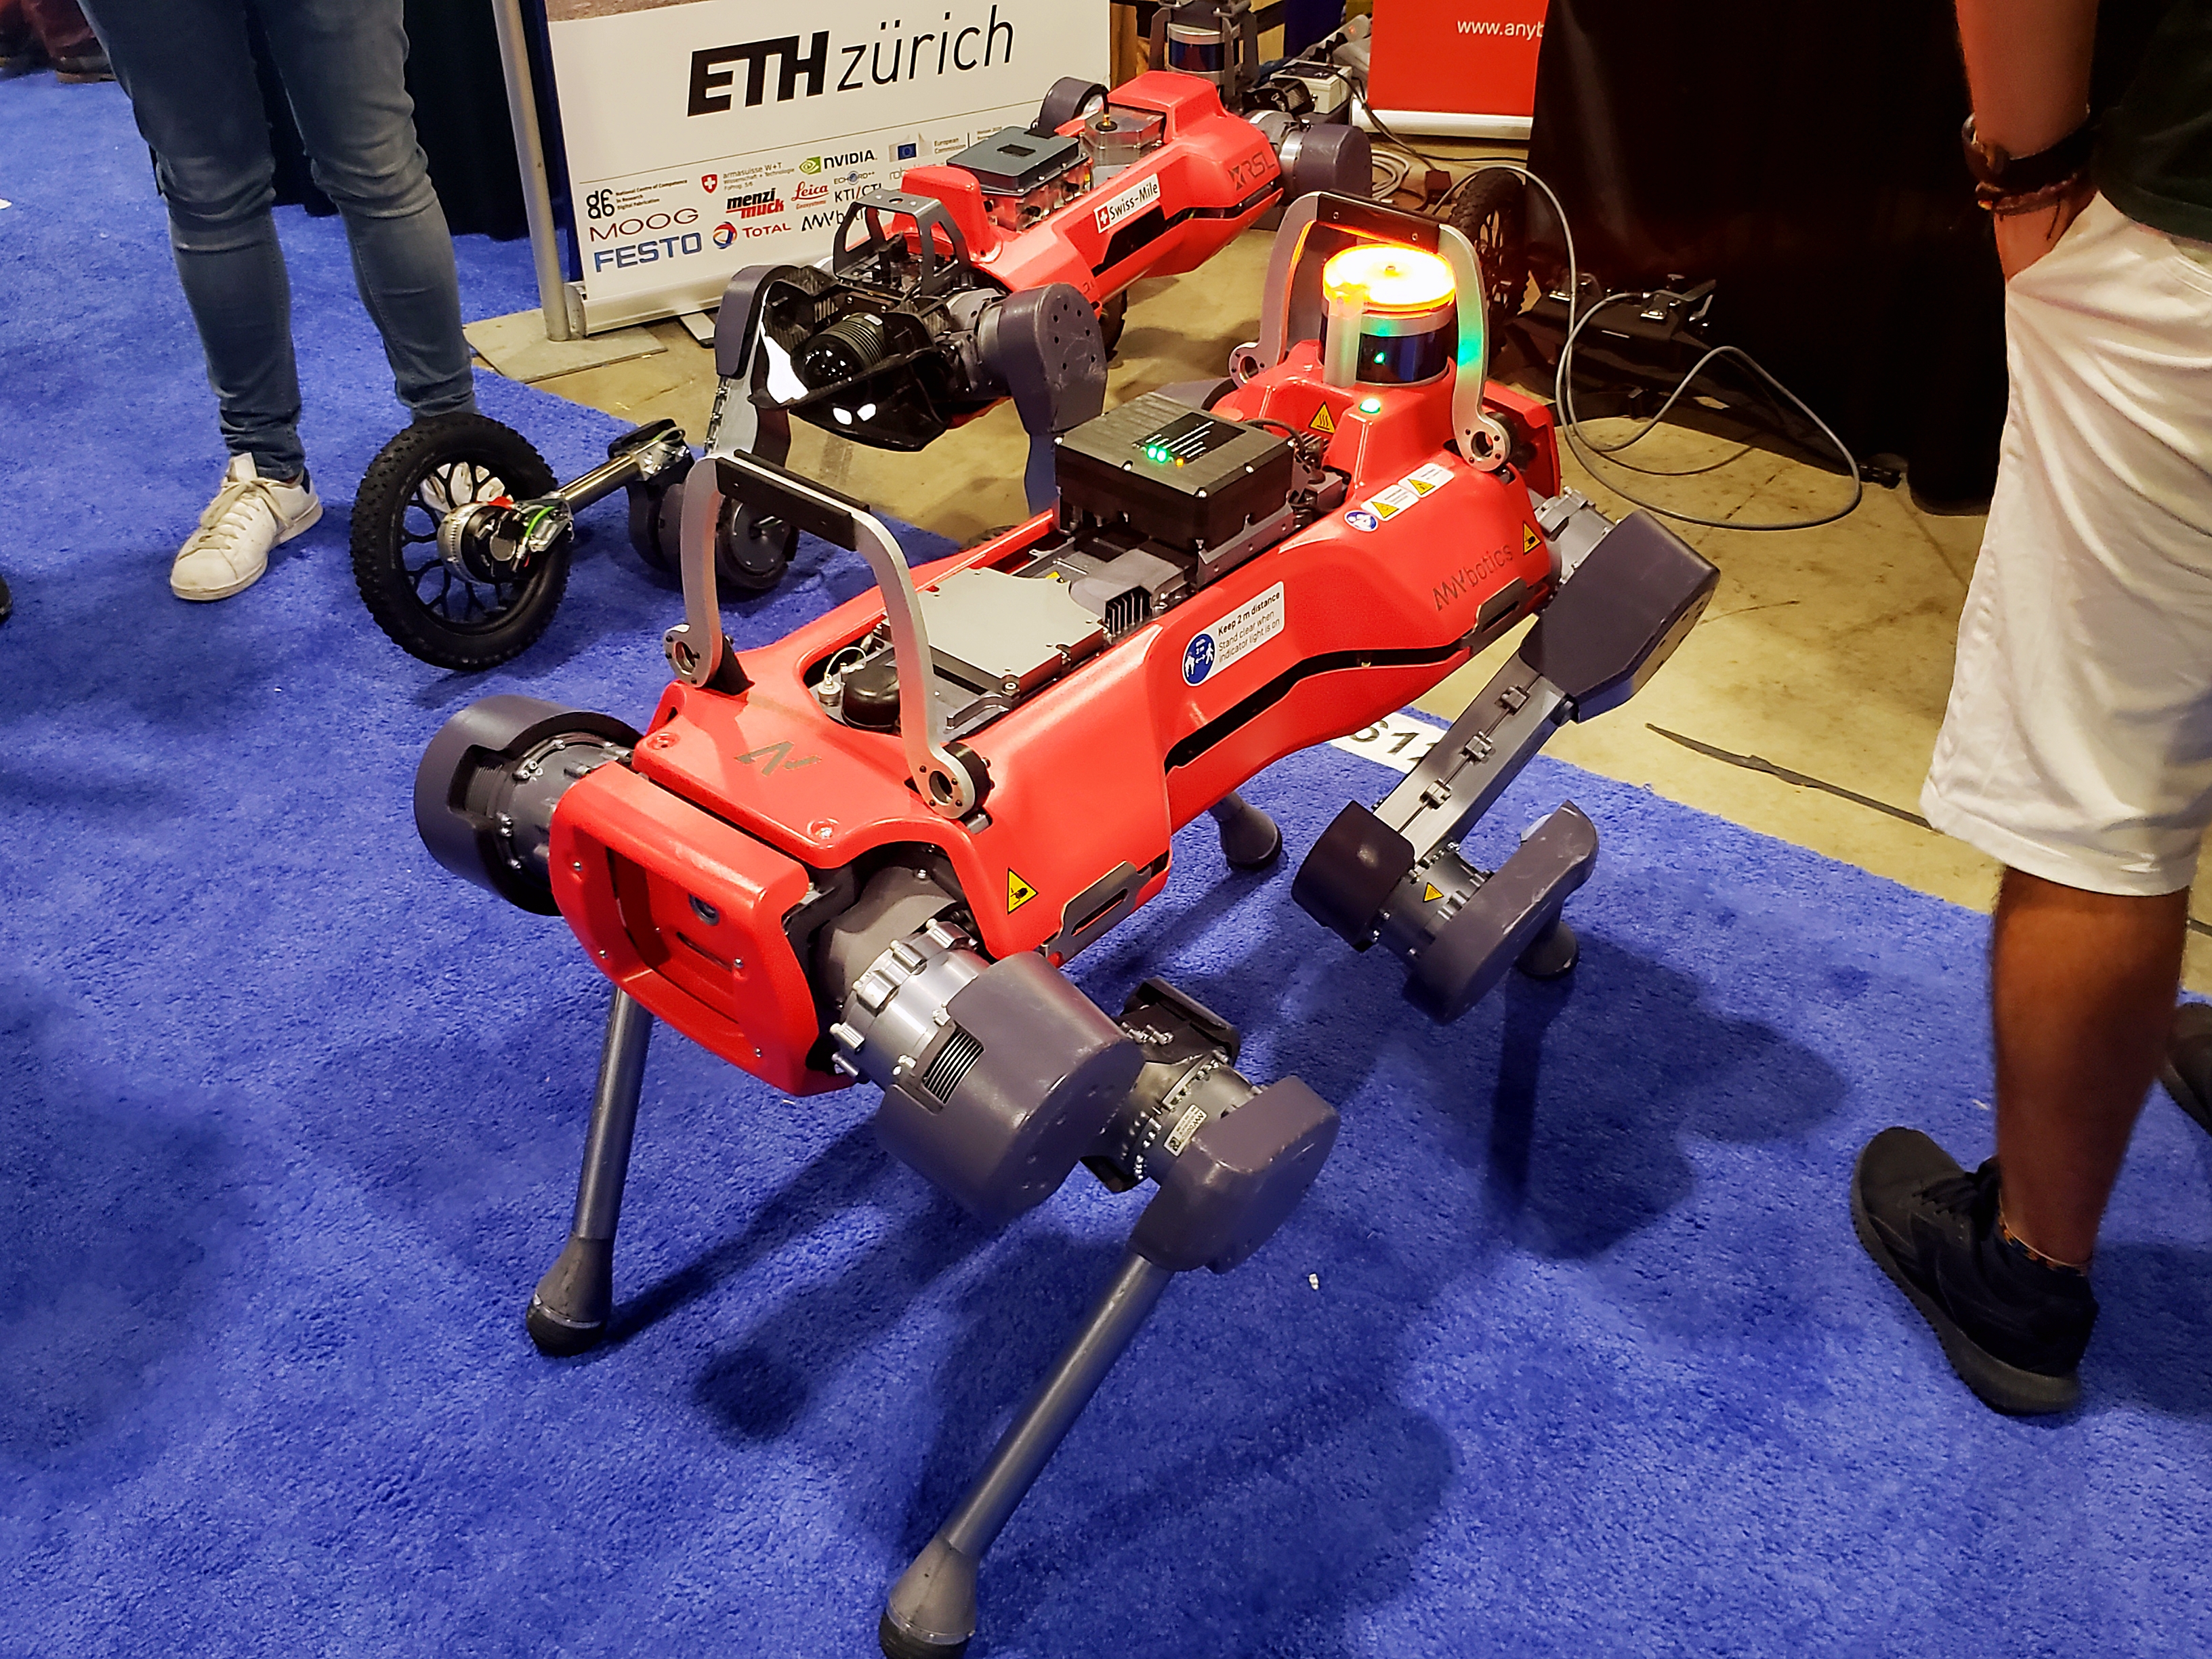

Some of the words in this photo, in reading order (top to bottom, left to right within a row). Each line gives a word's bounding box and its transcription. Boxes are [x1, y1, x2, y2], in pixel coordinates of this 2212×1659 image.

[687, 30, 830, 117] ETH
[837, 4, 1015, 93] zürich
[723, 166, 763, 179] armasuisse
[1244, 151, 1275, 181] RSL
[659, 180, 688, 188] Competence
[791, 181, 829, 201] Leica
[633, 198, 660, 207] Fabrication
[726, 188, 776, 209] menzi
[740, 198, 784, 219] muck
[796, 200, 826, 210] Geosystems
[1109, 182, 1159, 220] Swiss-Mile
[589, 208, 699, 243] MOOG
[742, 223, 791, 238] TOTAL
[593, 232, 703, 272] FESTO
[1217, 620, 1236, 637] Keep
[1237, 614, 1242, 625] 2
[1243, 611, 1250, 621] m
[1251, 592, 1280, 615] distance
[1219, 633, 1238, 652] Stand
[1239, 623, 1255, 638] clear
[1257, 610, 1274, 627] when
[1219, 639, 1248, 663] indicator
[1249, 628, 1264, 644] light
[1265, 624, 1271, 634] is
[1272, 618, 1280, 629] on
